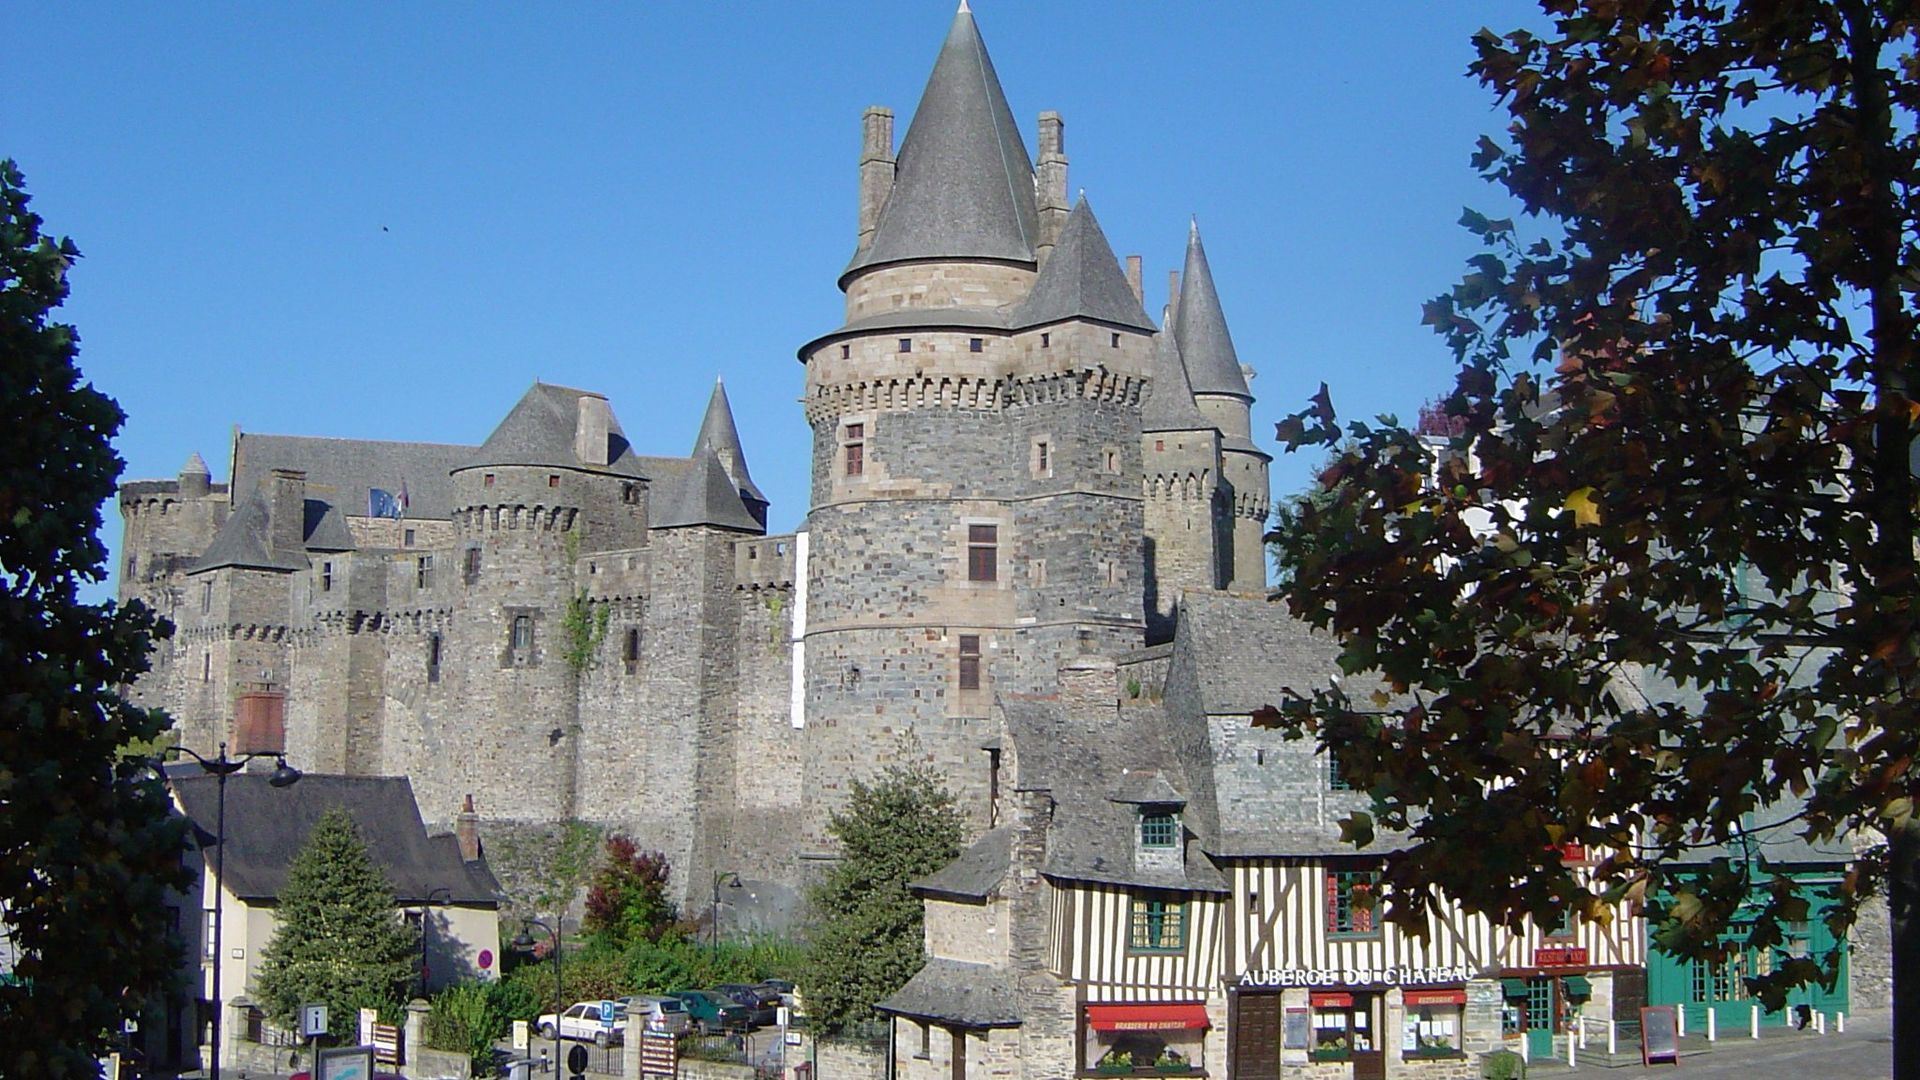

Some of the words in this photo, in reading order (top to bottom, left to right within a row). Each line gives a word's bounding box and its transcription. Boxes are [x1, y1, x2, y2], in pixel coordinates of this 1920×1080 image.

[1240, 969, 1335, 986] AUBERGE
[1344, 968, 1372, 986] DU
[1382, 966, 1475, 985] CHATEAU
[603, 1004, 610, 1016] P
